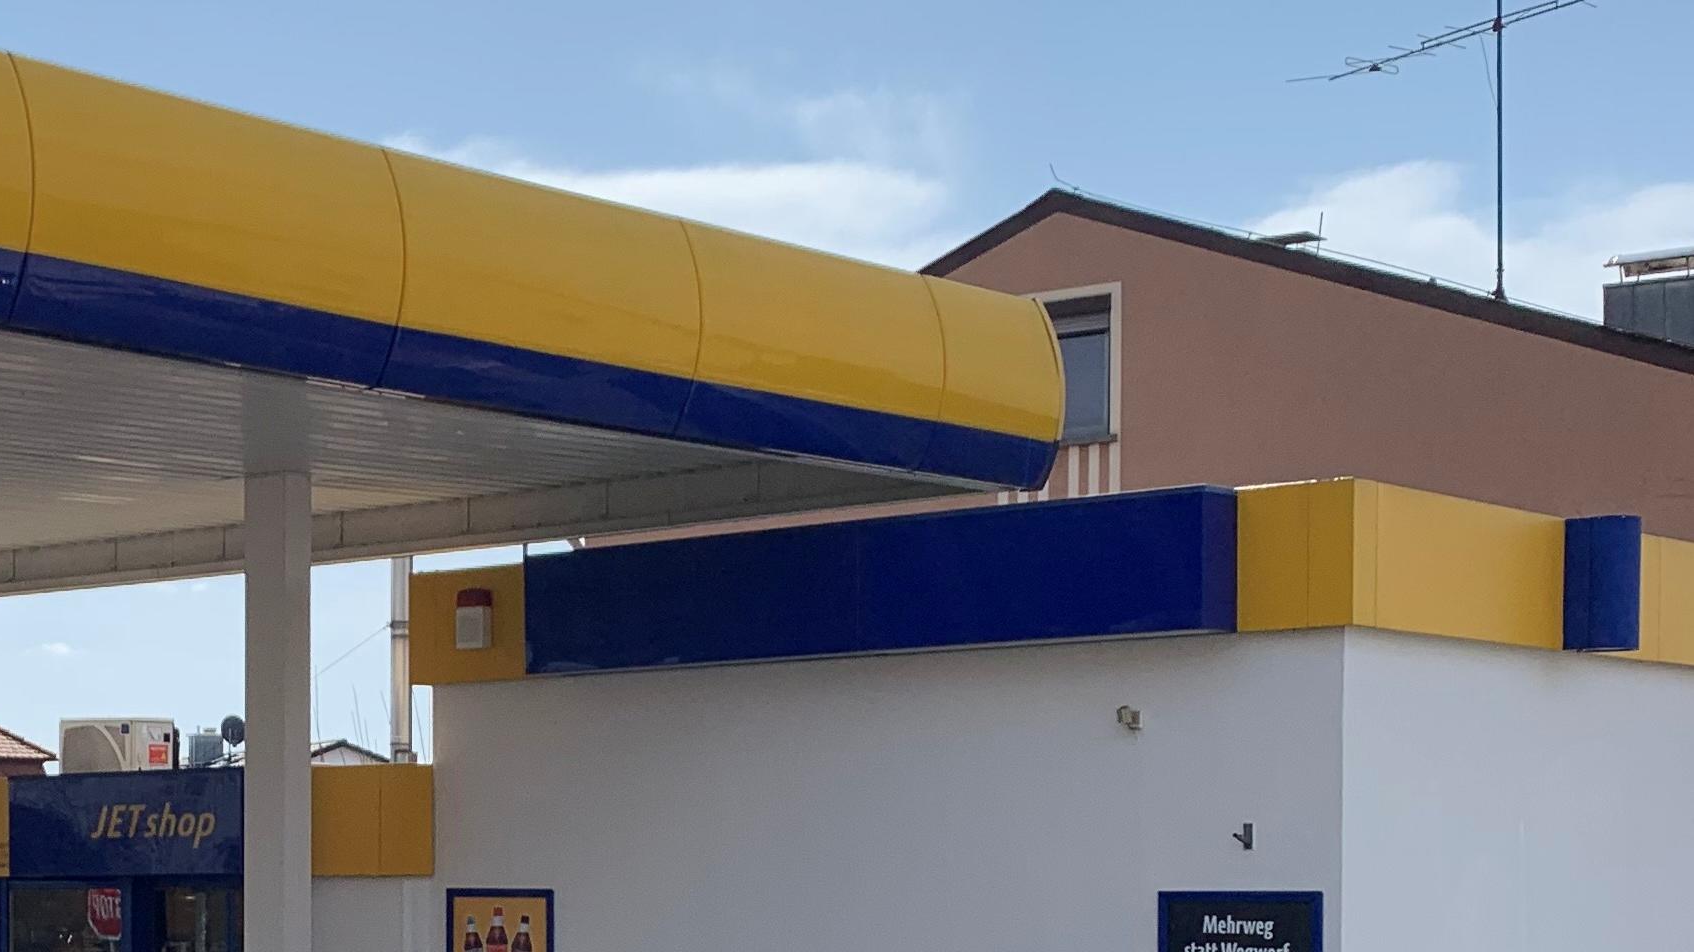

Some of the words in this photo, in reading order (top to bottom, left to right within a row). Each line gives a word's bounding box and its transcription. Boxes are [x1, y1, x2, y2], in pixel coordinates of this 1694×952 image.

[91, 804, 146, 839] JET
[144, 801, 216, 848] shop
[1203, 915, 1274, 939] Mehrweg
